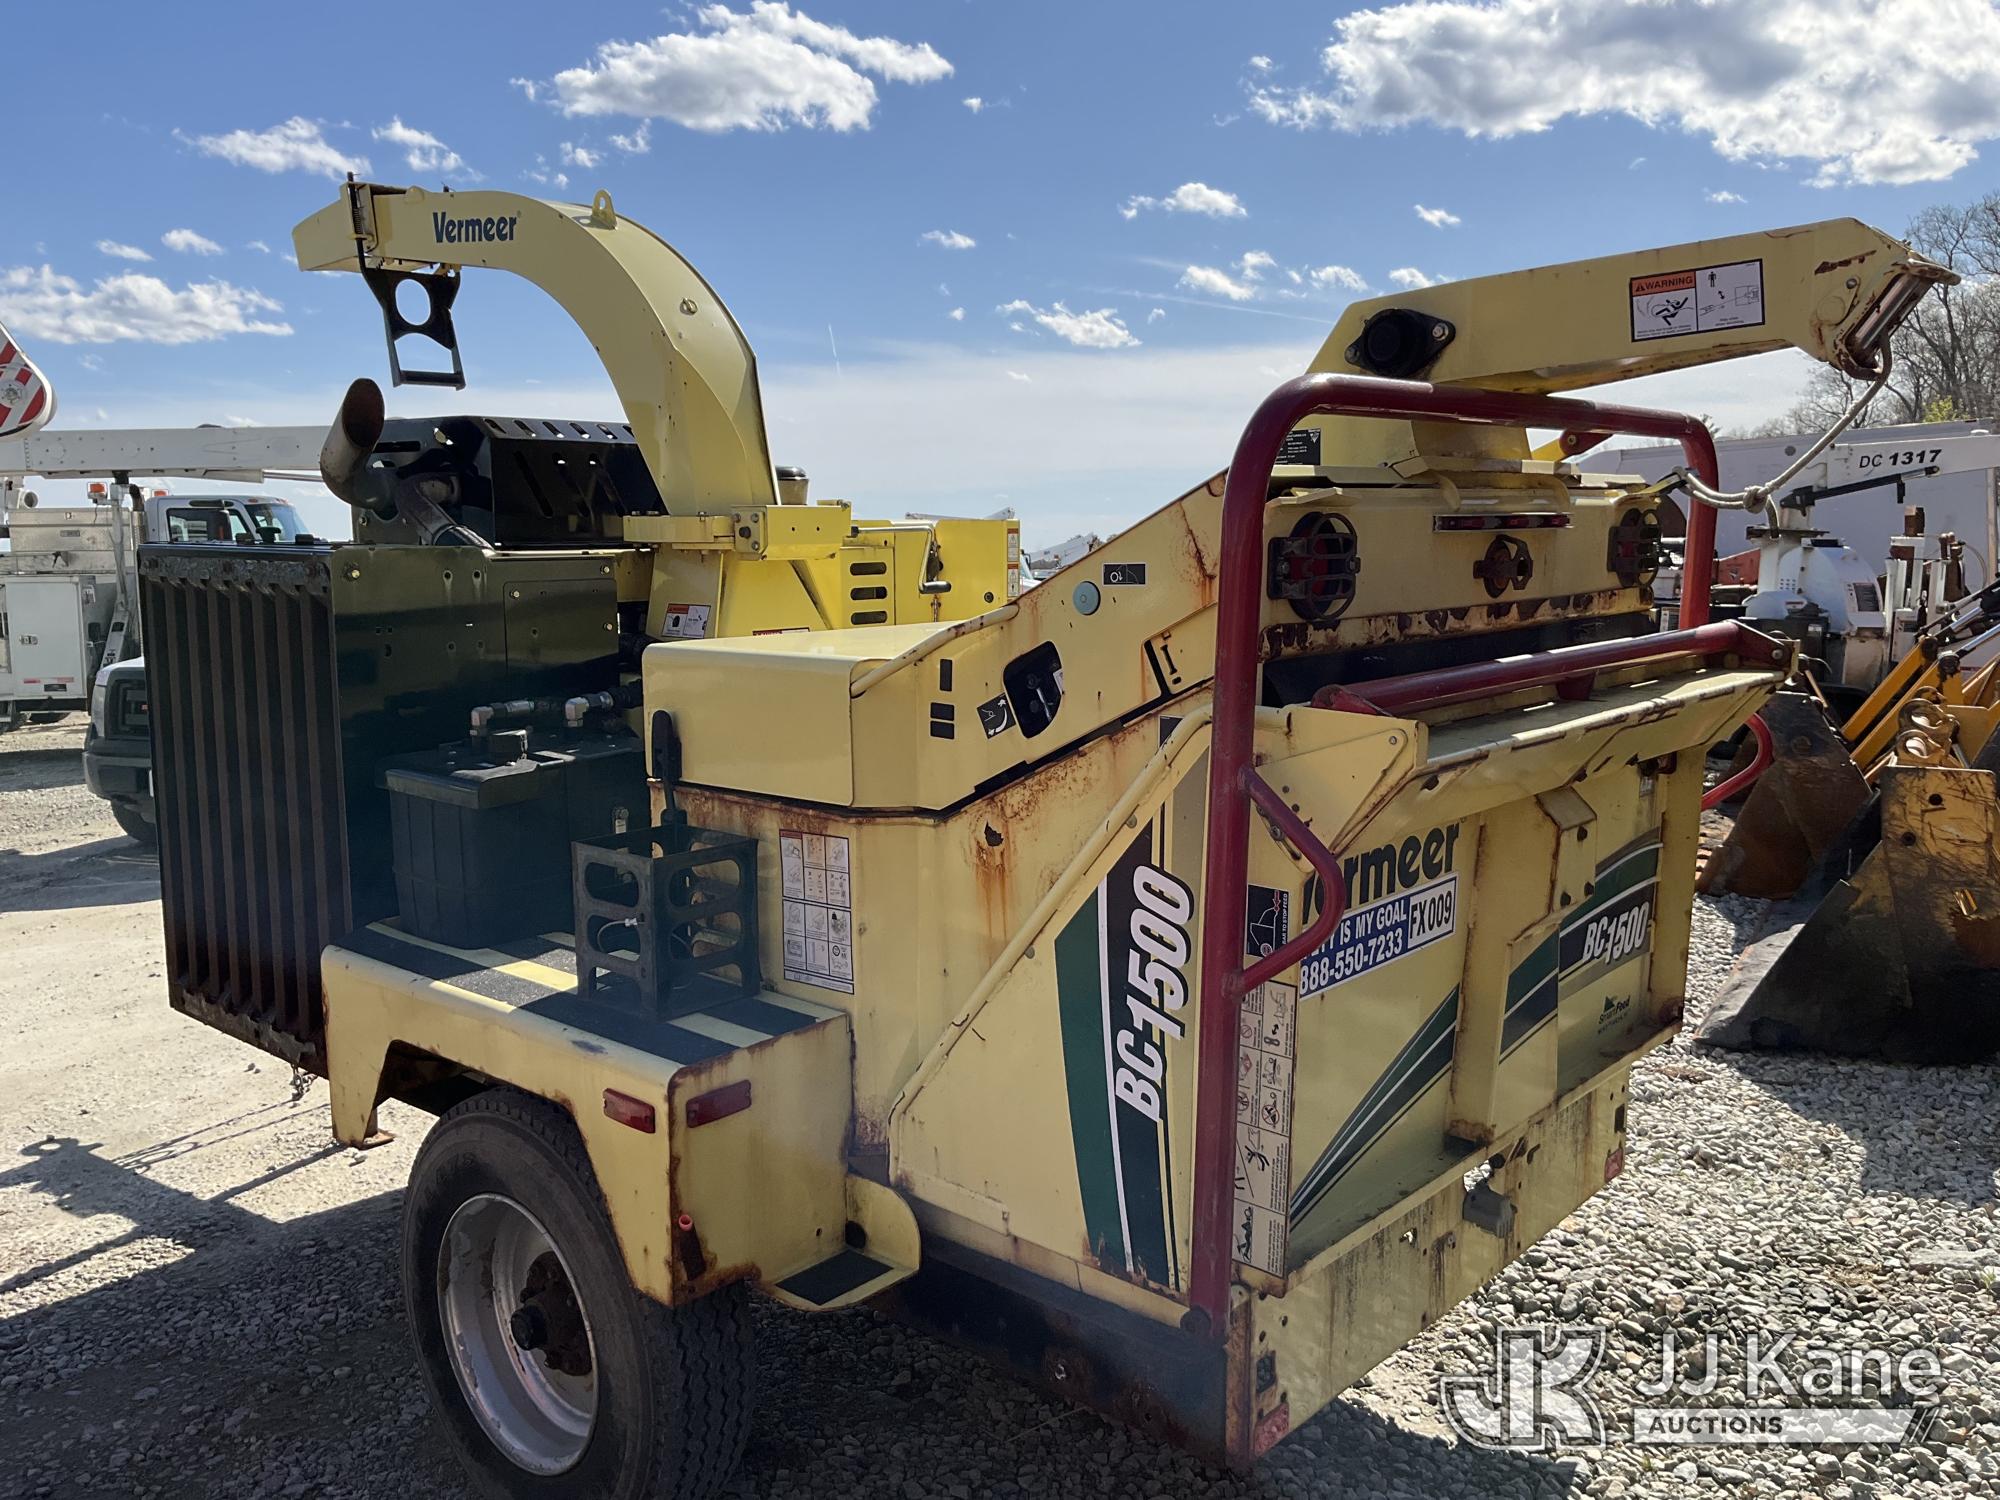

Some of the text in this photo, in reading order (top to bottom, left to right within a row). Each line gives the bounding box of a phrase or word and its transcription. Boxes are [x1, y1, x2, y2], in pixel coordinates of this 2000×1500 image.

[432, 211, 517, 243] Vermeer
[1645, 276, 1693, 289] WARNING
[1859, 449, 1942, 468] DC 1317
[1340, 899, 1407, 946] IS MY GOAL
[1409, 890, 1453, 940] FX009
